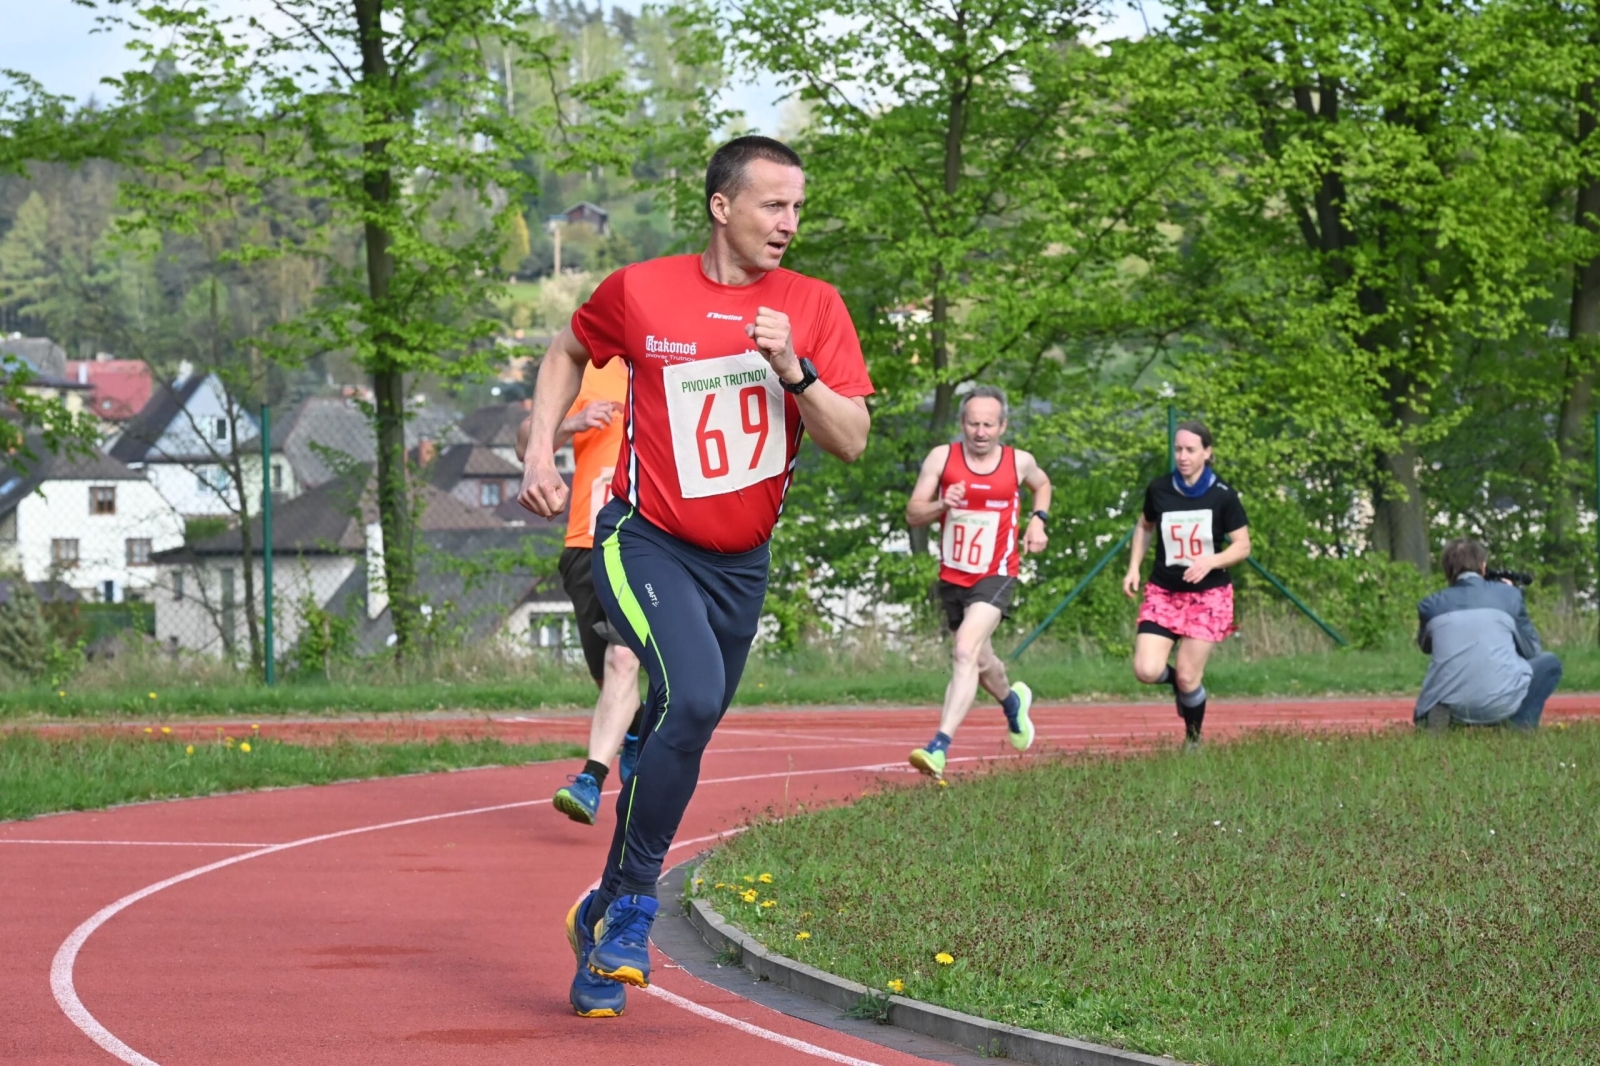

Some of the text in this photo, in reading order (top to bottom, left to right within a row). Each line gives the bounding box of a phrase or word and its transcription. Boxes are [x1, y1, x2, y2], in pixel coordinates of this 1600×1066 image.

[681, 368, 767, 393] PIVOVAR TRUTNOV
[696, 385, 769, 479] 69
[952, 524, 984, 566] 86
[1170, 523, 1203, 559] 56
